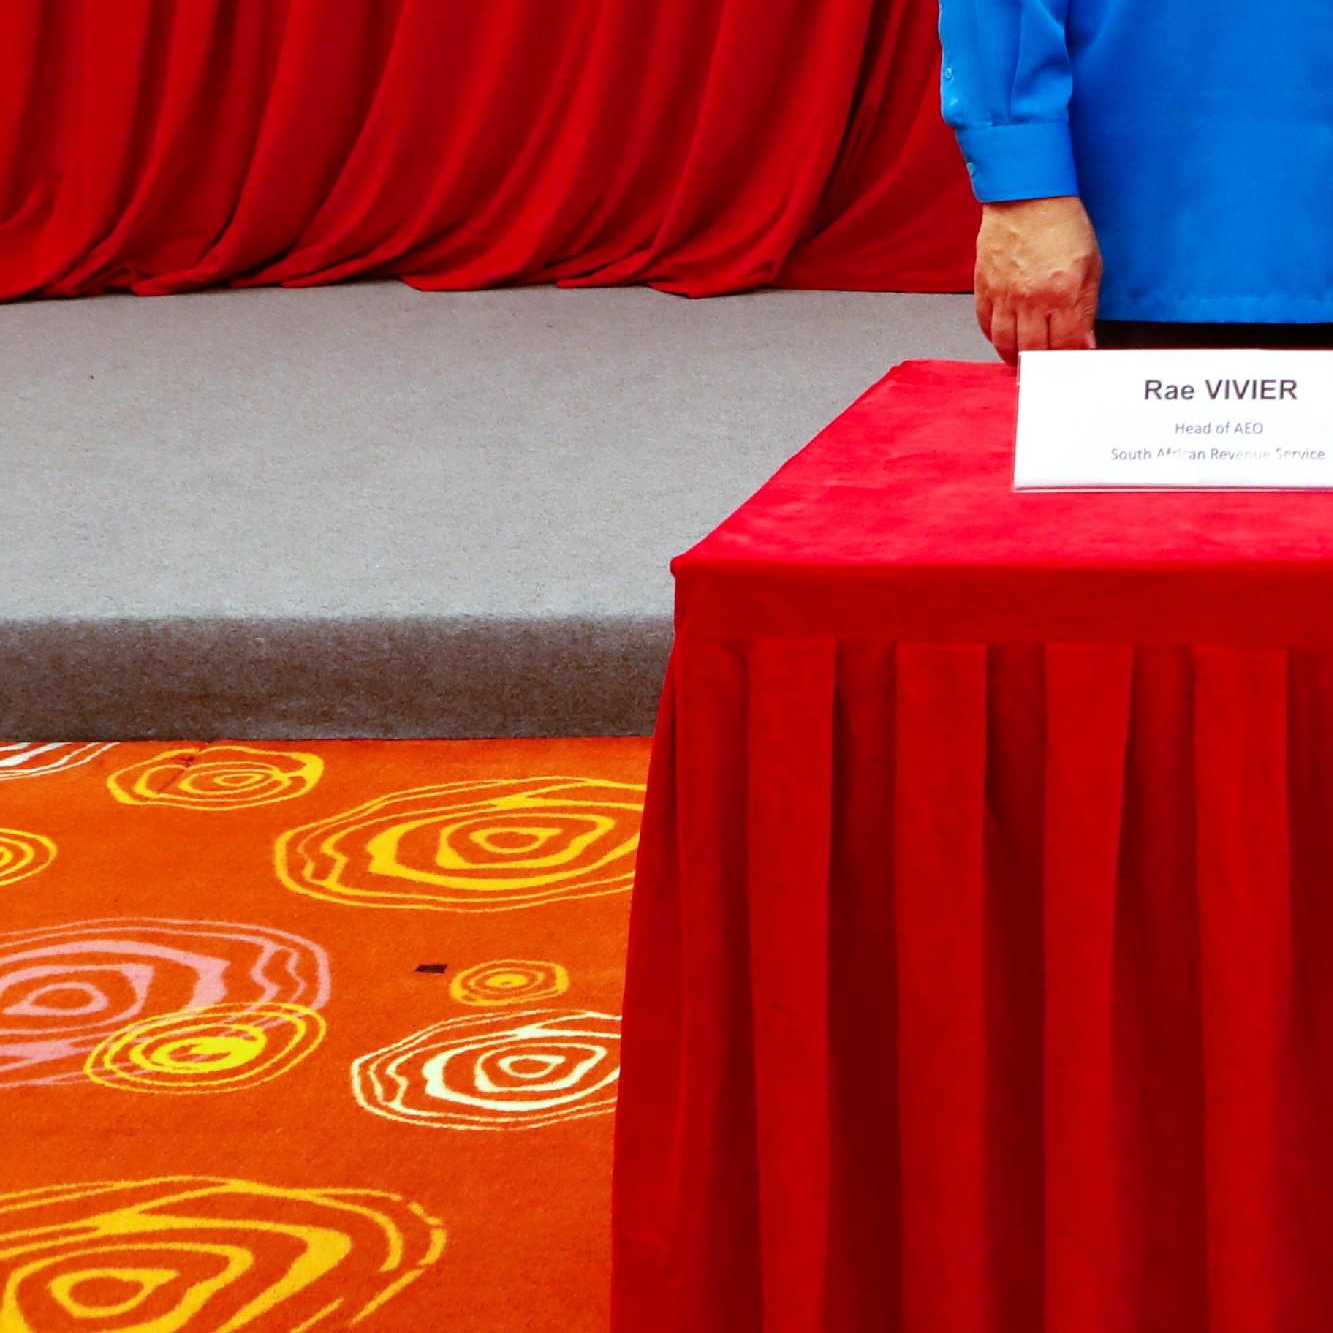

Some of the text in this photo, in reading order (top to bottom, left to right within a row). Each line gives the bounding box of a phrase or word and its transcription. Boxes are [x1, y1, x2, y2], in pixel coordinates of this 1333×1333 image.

[1144, 379, 1298, 400] Rae VIVIER
[1174, 421, 1264, 435] Head of AEO
[1110, 447, 1152, 461] South
[1275, 447, 1326, 460] Service
